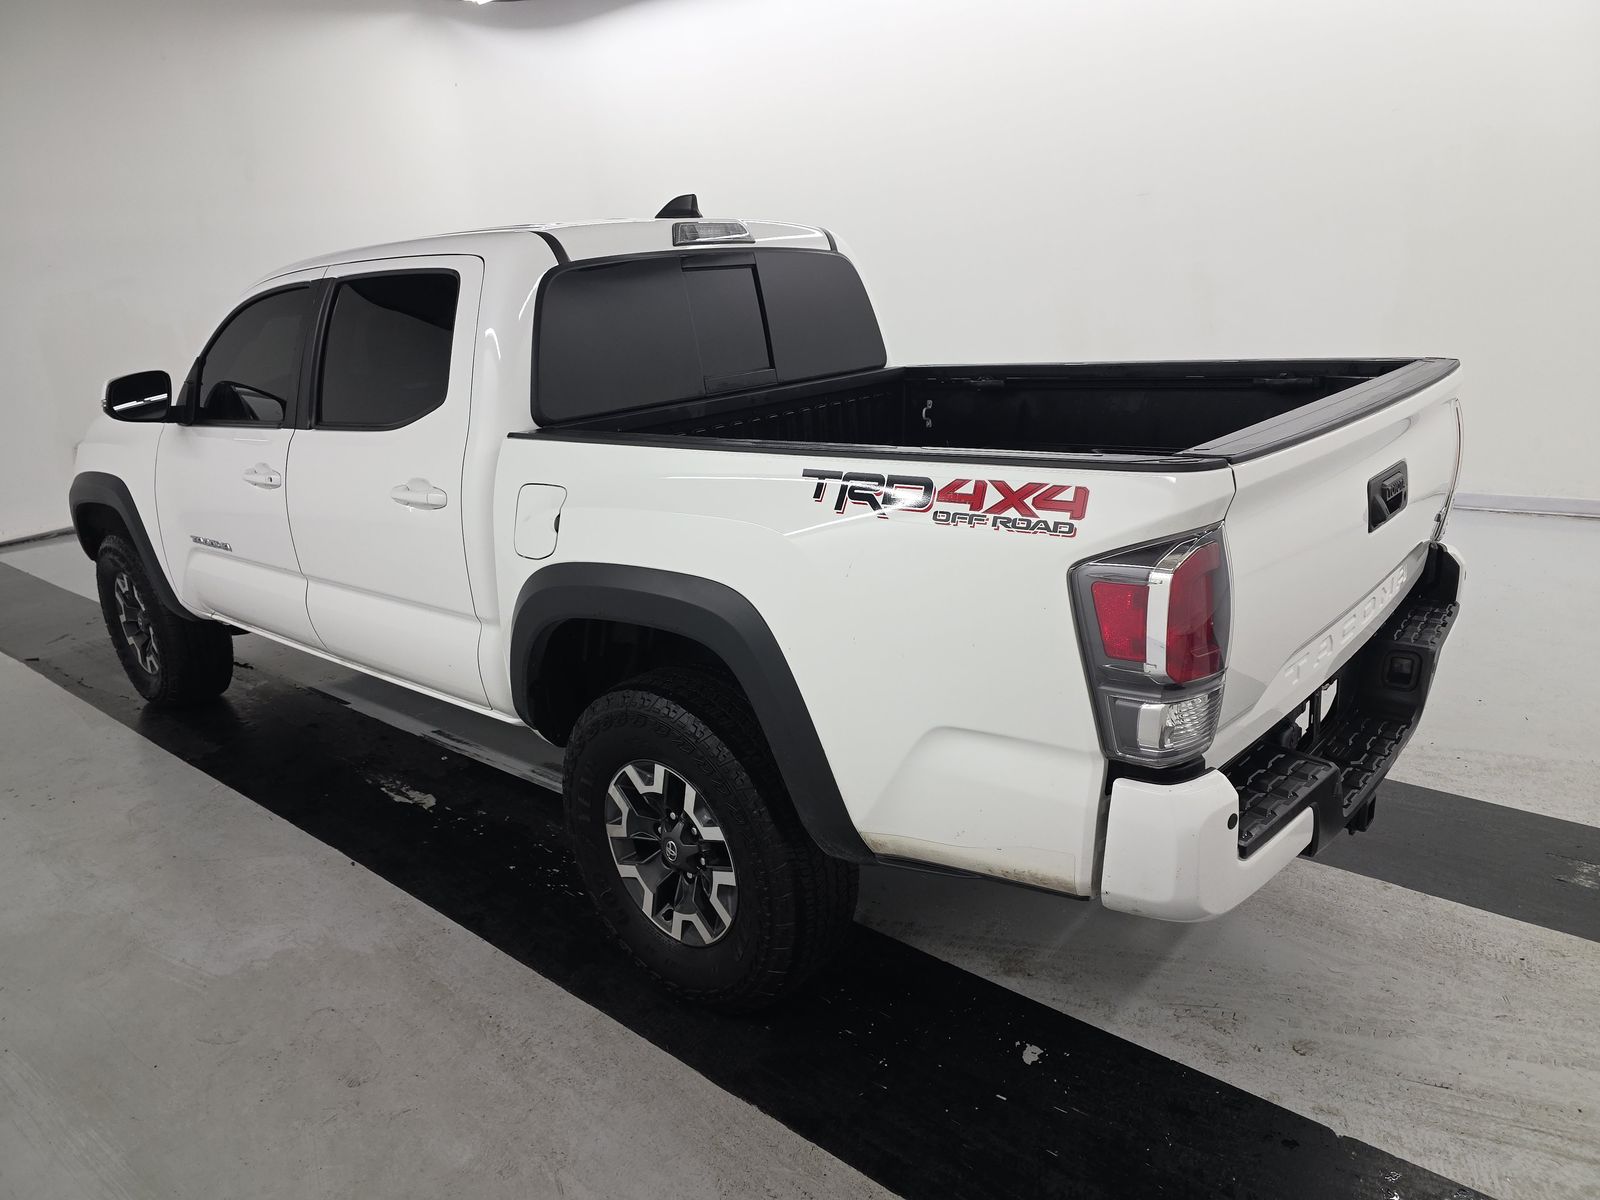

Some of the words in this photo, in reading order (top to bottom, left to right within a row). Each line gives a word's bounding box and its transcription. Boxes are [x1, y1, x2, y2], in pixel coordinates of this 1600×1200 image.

[802, 468, 936, 519] TRD
[936, 477, 1090, 521] 4X4
[932, 510, 989, 528] OFF
[991, 515, 1078, 538] ROAD
